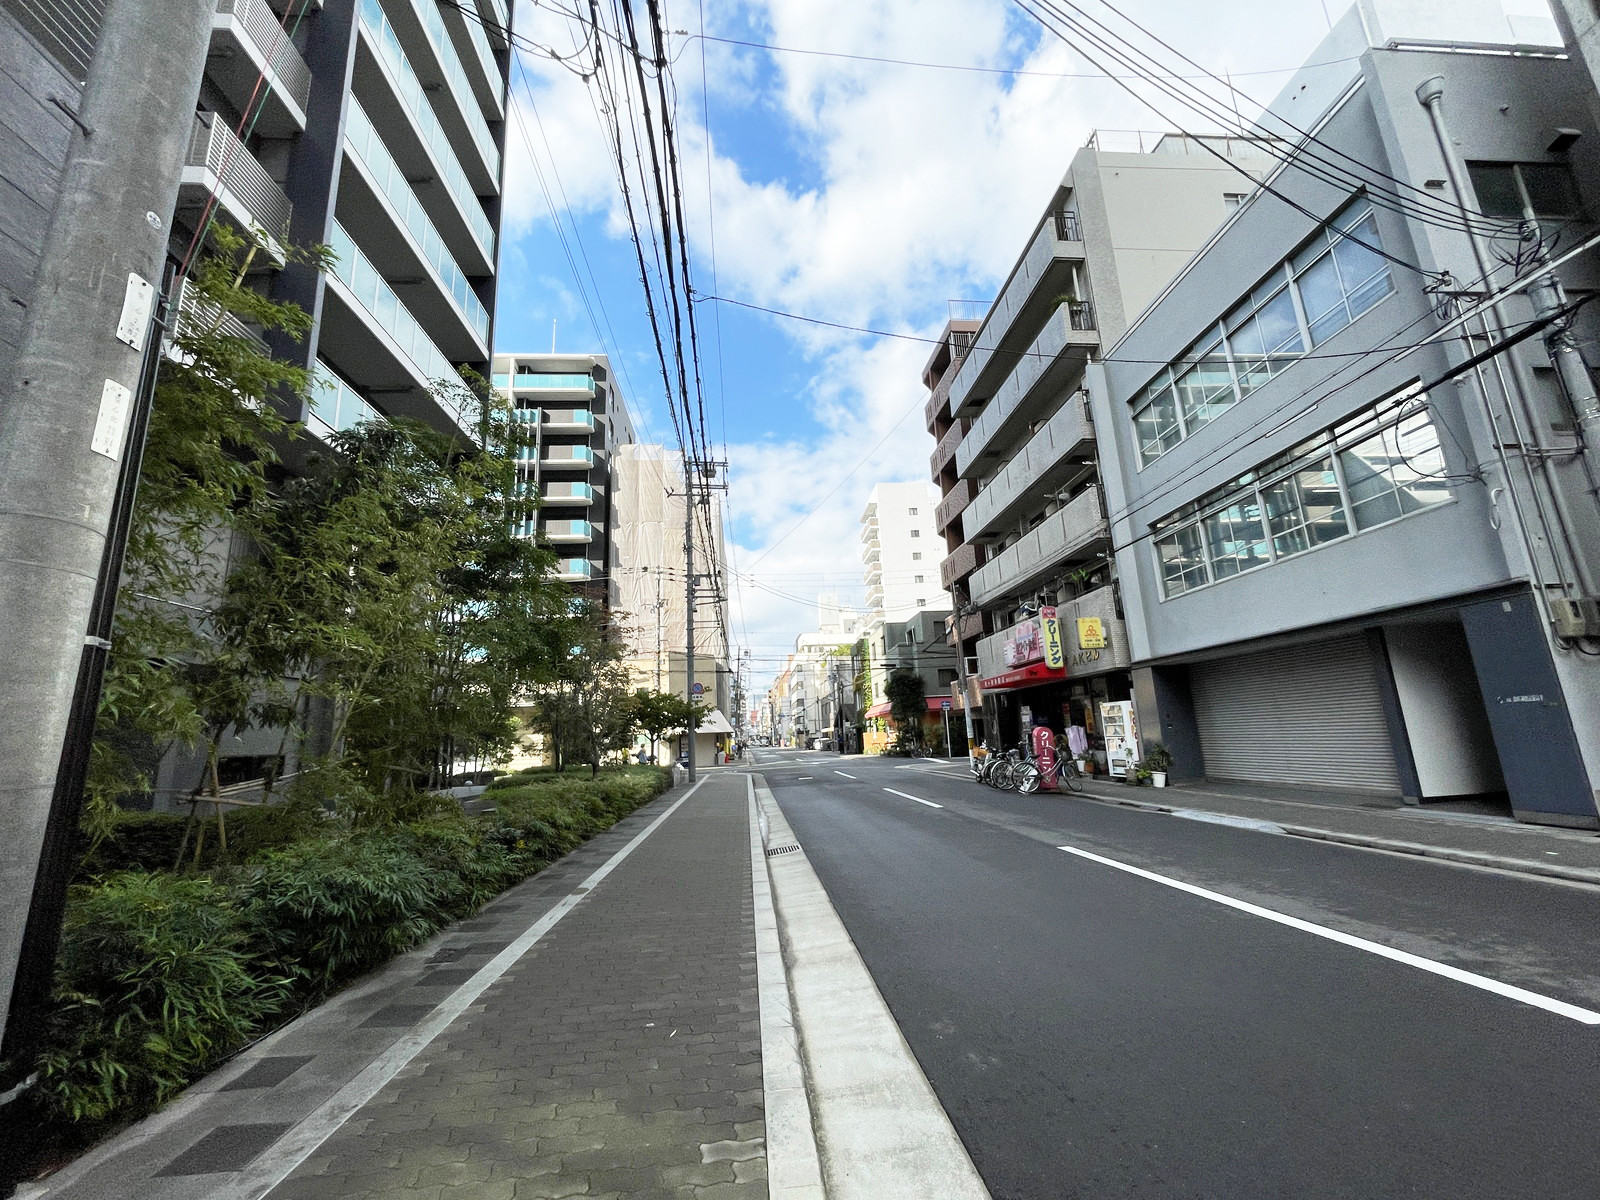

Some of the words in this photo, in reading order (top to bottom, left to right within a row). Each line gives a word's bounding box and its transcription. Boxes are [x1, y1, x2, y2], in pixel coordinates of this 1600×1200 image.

[1046, 619, 1062, 665] クリーニング
[1040, 731, 1052, 776] クリーニン
